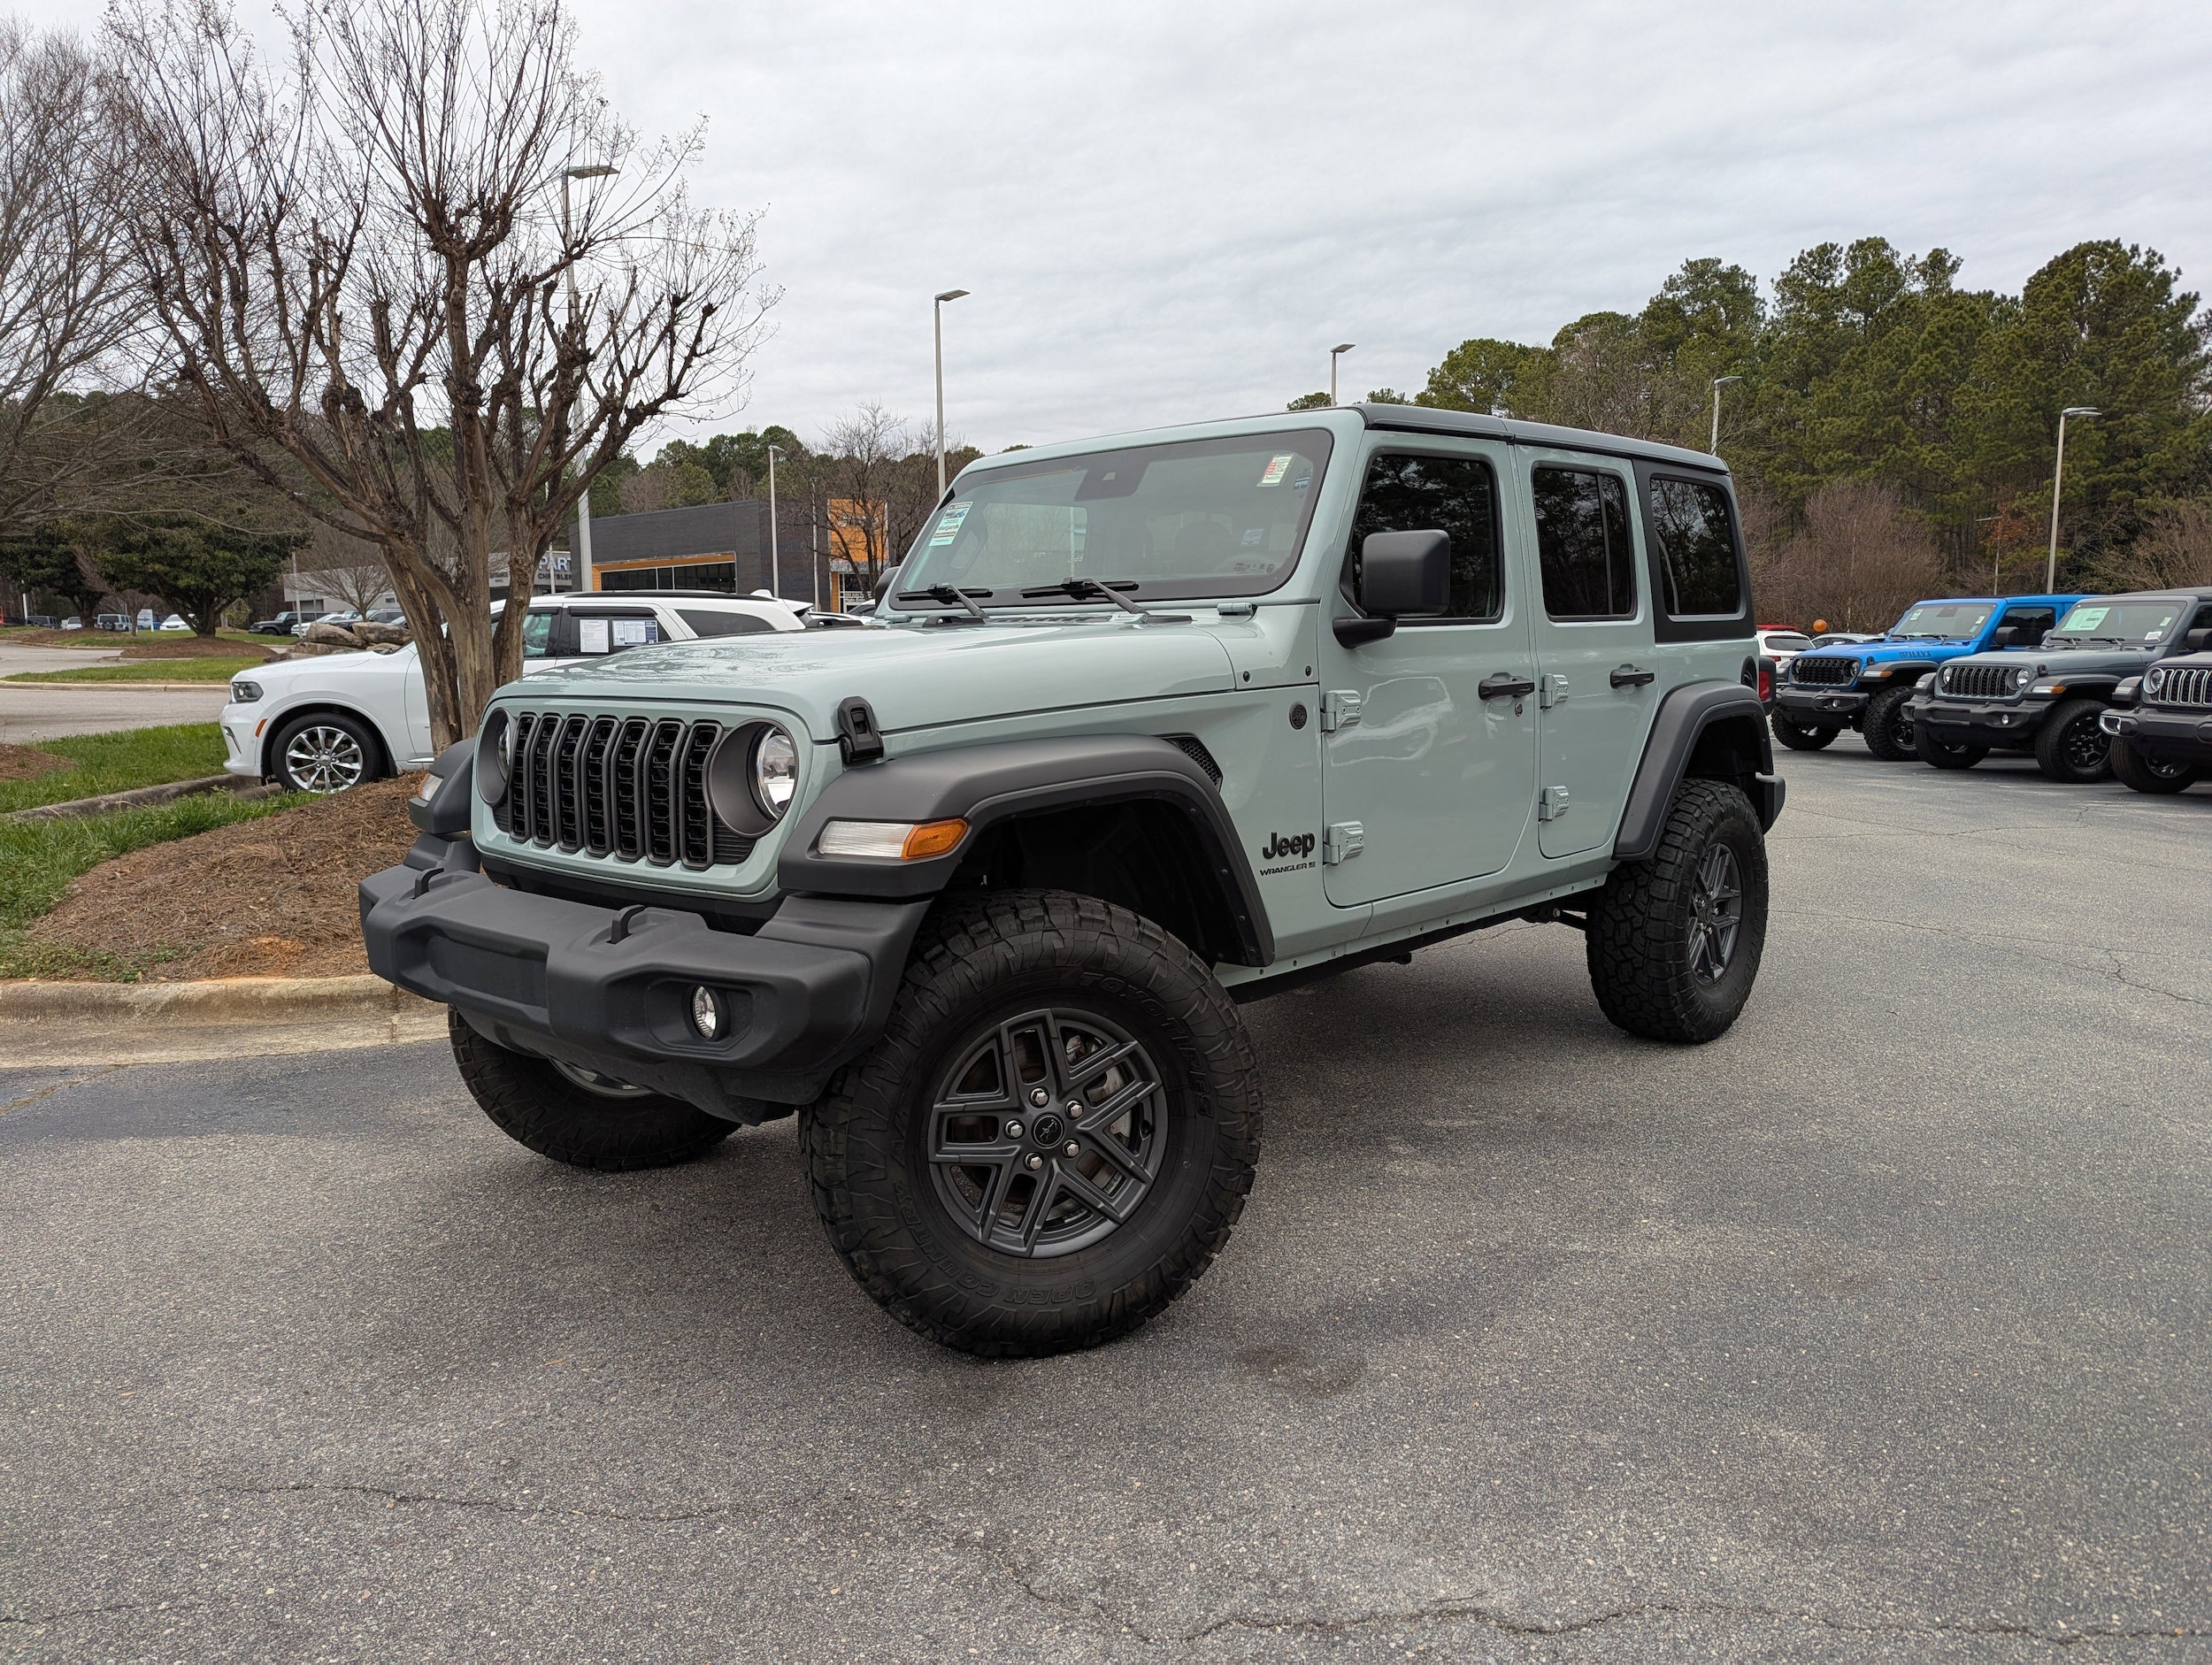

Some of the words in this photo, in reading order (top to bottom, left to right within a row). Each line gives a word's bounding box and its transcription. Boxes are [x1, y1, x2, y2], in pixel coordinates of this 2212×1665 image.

[539, 556, 572, 572] PAR
[1899, 650, 1932, 659] WILLYS
[1263, 832, 1316, 860] Jeep
[1260, 863, 1308, 876] WRANGLER
[1079, 971, 1165, 1017] TOYO
[1161, 1017, 1215, 1119] TIRES
[895, 1182, 1000, 1298] COUNTRY
[1003, 1280, 1097, 1305] OPEN
